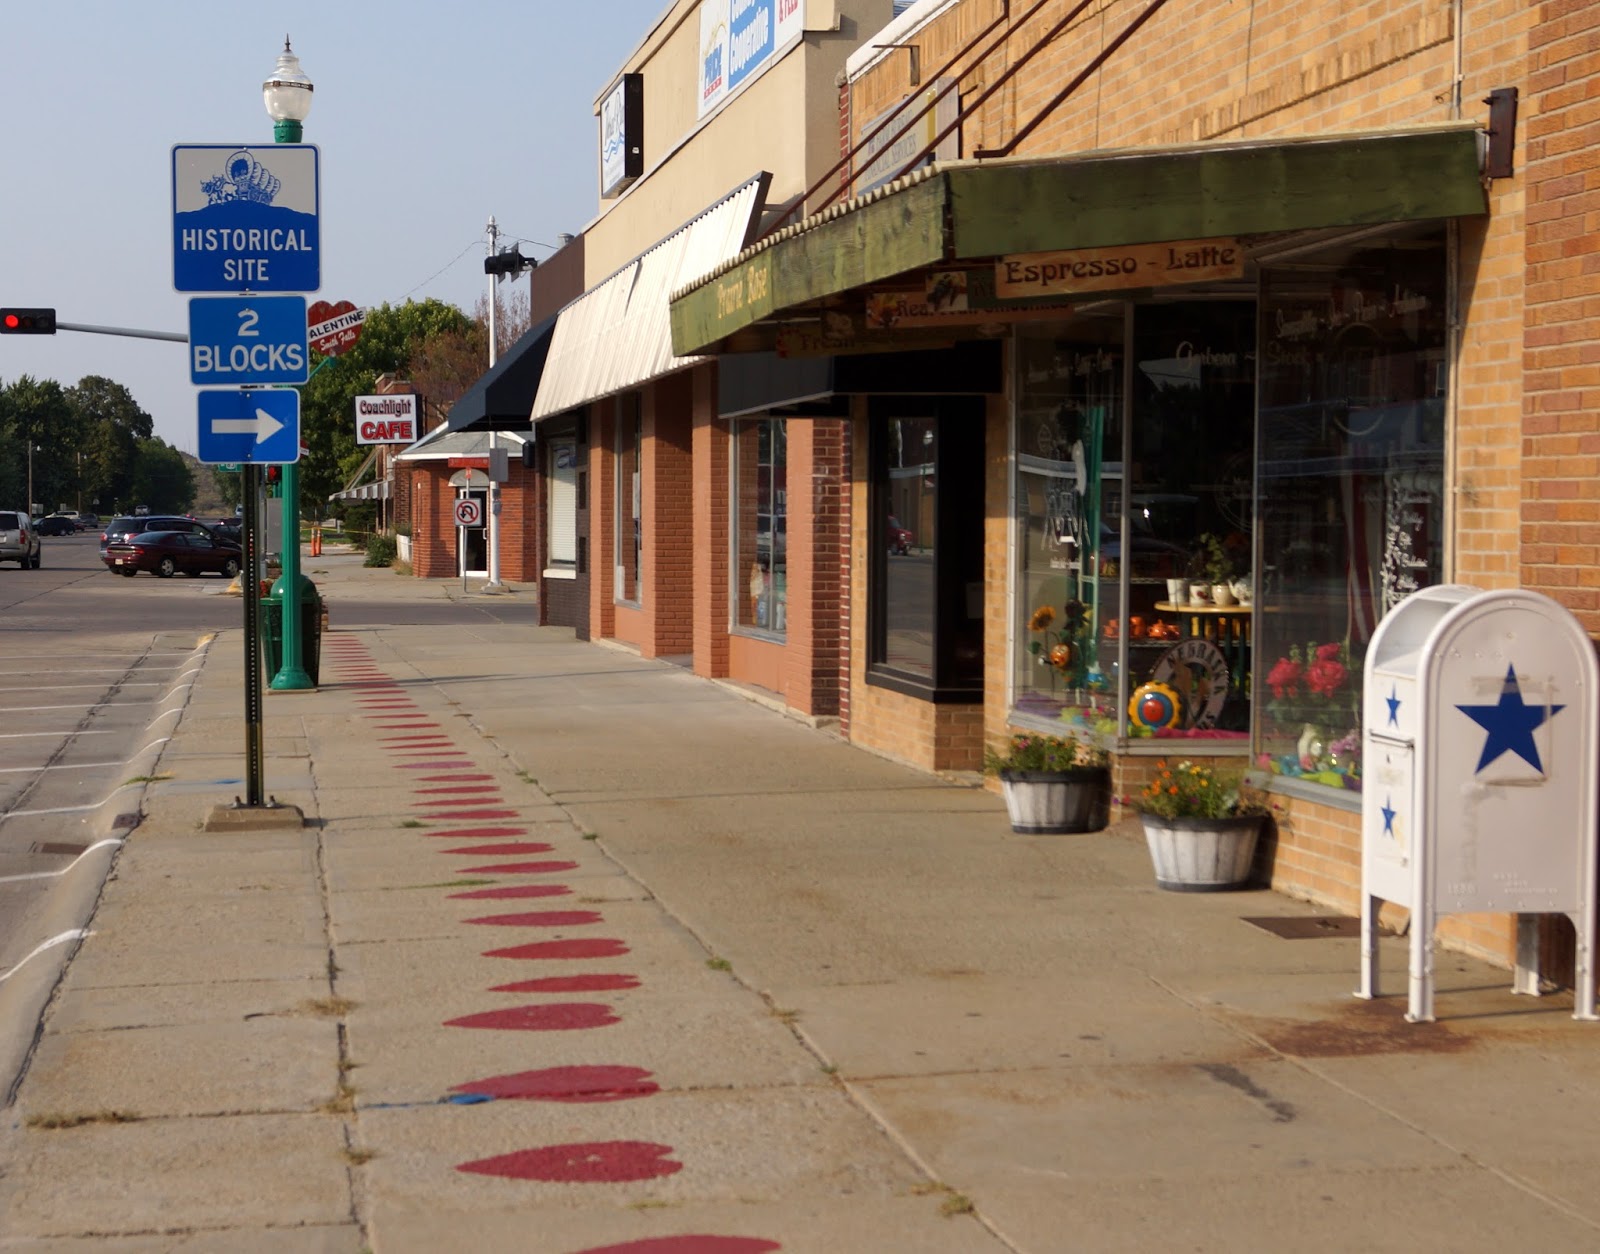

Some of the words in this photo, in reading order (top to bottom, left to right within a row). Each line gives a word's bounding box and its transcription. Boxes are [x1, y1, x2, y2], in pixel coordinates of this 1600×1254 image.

[182, 229, 312, 251] HISTORICAL
[223, 259, 269, 281] SITE
[1004, 255, 1138, 287] Espresso
[1167, 244, 1236, 270] Latte
[238, 310, 259, 336] 2
[309, 310, 365, 339] ALENTINE
[194, 344, 304, 373] BLOCKS
[359, 400, 411, 418] Coachlight
[360, 421, 413, 440] CAFE
